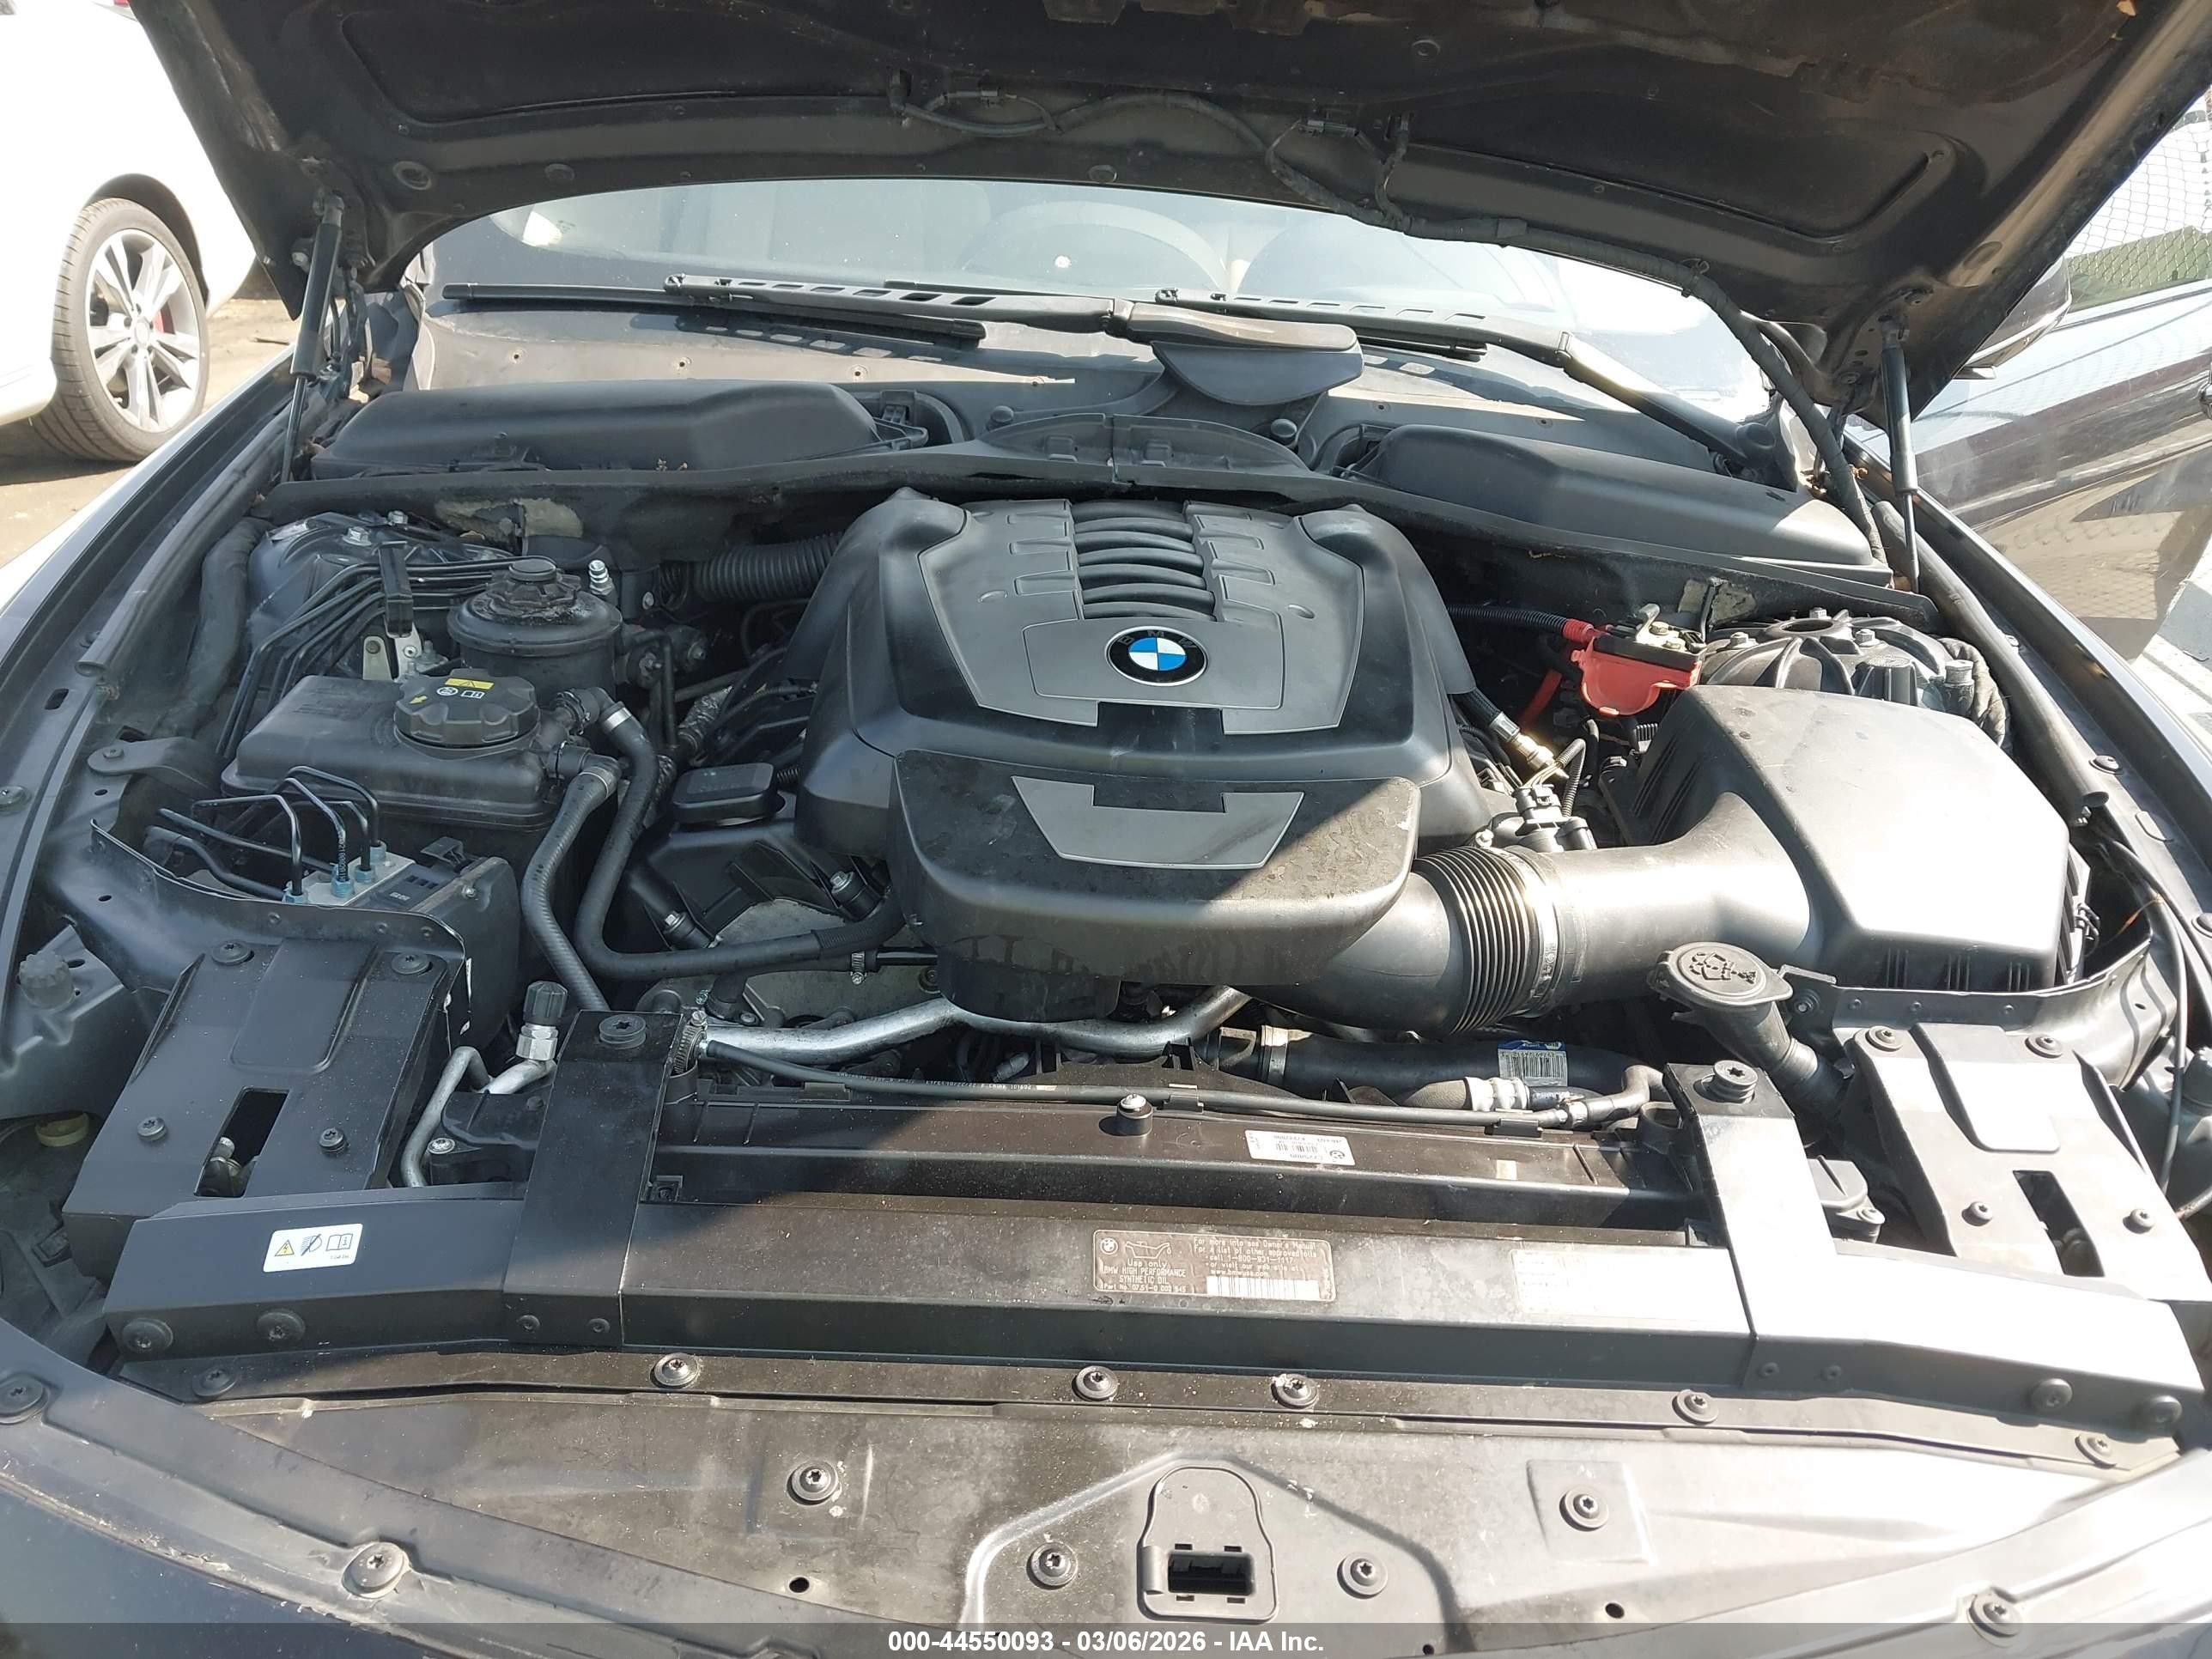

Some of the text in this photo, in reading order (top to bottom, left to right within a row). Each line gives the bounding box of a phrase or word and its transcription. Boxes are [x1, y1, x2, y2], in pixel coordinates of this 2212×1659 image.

[1116, 629, 1197, 648] BMW
[1127, 1258, 1169, 1269] Use only
[1103, 1266, 1187, 1278] BMW HIGH PERFORMANCE
[1119, 1274, 1170, 1285] SYNTHETIC OIL
